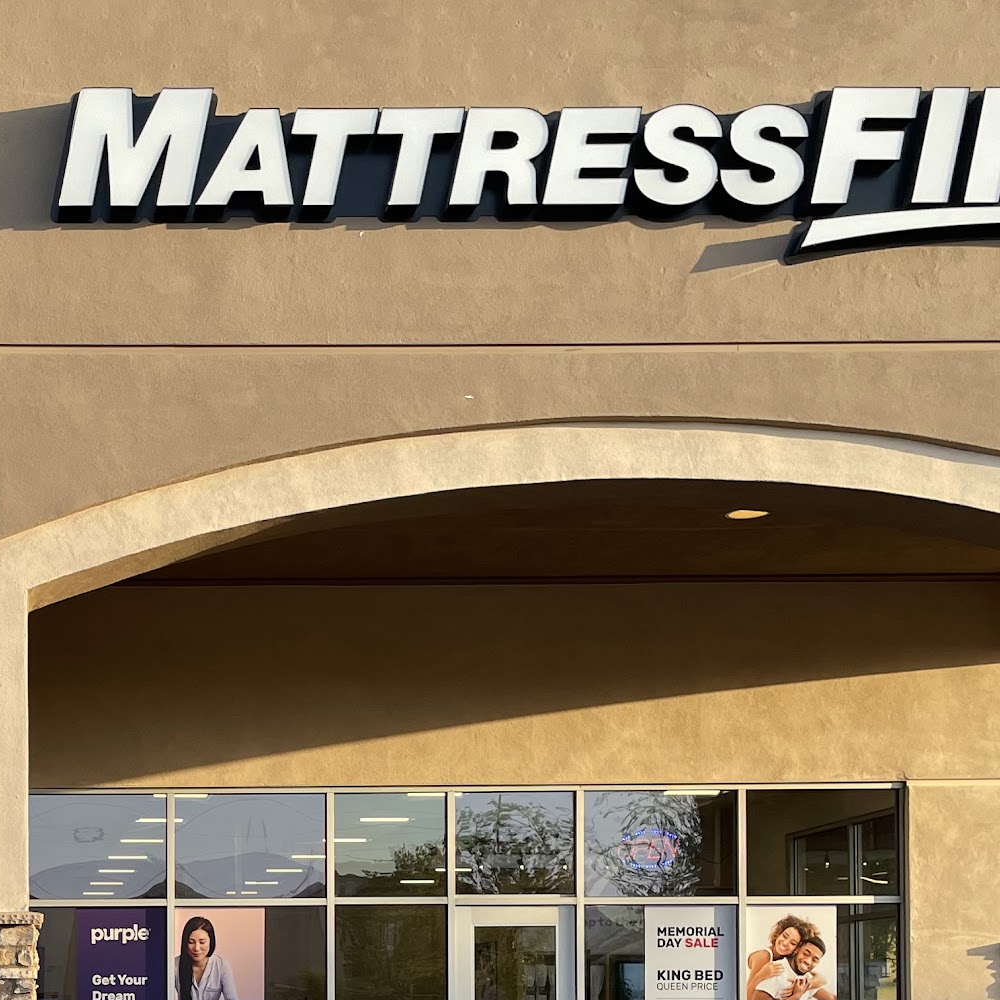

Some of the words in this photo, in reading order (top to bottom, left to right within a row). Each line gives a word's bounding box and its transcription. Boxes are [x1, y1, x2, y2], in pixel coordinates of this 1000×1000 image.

[617, 837, 680, 860] OPEN
[91, 924, 149, 944] purple
[657, 926, 725, 937] MEMORIAL
[657, 938, 682, 948] DAY
[685, 938, 719, 948] SALE
[92, 974, 116, 986] Get
[117, 974, 148, 986] Your
[657, 970, 691, 981] KING
[694, 970, 724, 981] BED
[656, 982, 688, 991] QUEEN
[690, 982, 719, 991] PRICE
